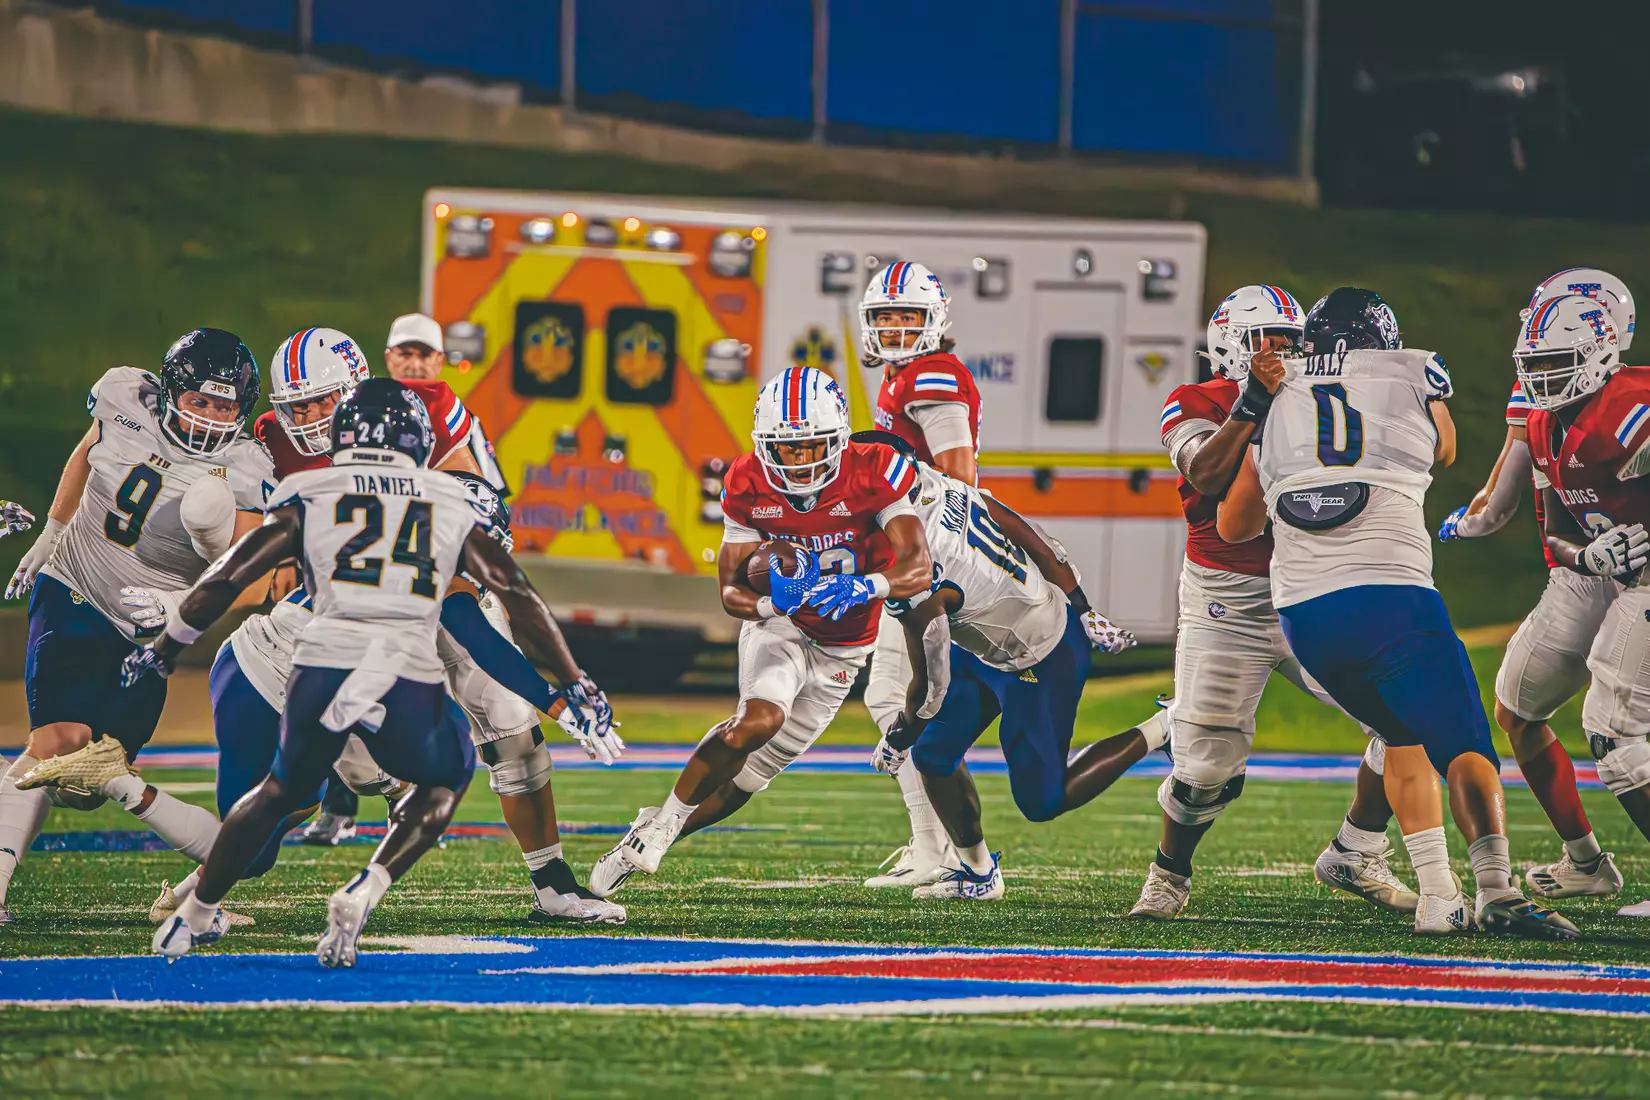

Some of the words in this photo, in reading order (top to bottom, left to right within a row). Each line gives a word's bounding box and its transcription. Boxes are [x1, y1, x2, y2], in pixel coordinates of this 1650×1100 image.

[1304, 351, 1348, 376] DALY
[357, 421, 386, 443] 24
[1309, 381, 1366, 469] 0
[149, 452, 172, 470] FIU
[353, 475, 421, 498] DANIEL
[103, 461, 165, 551] 9
[330, 492, 440, 602] 24
